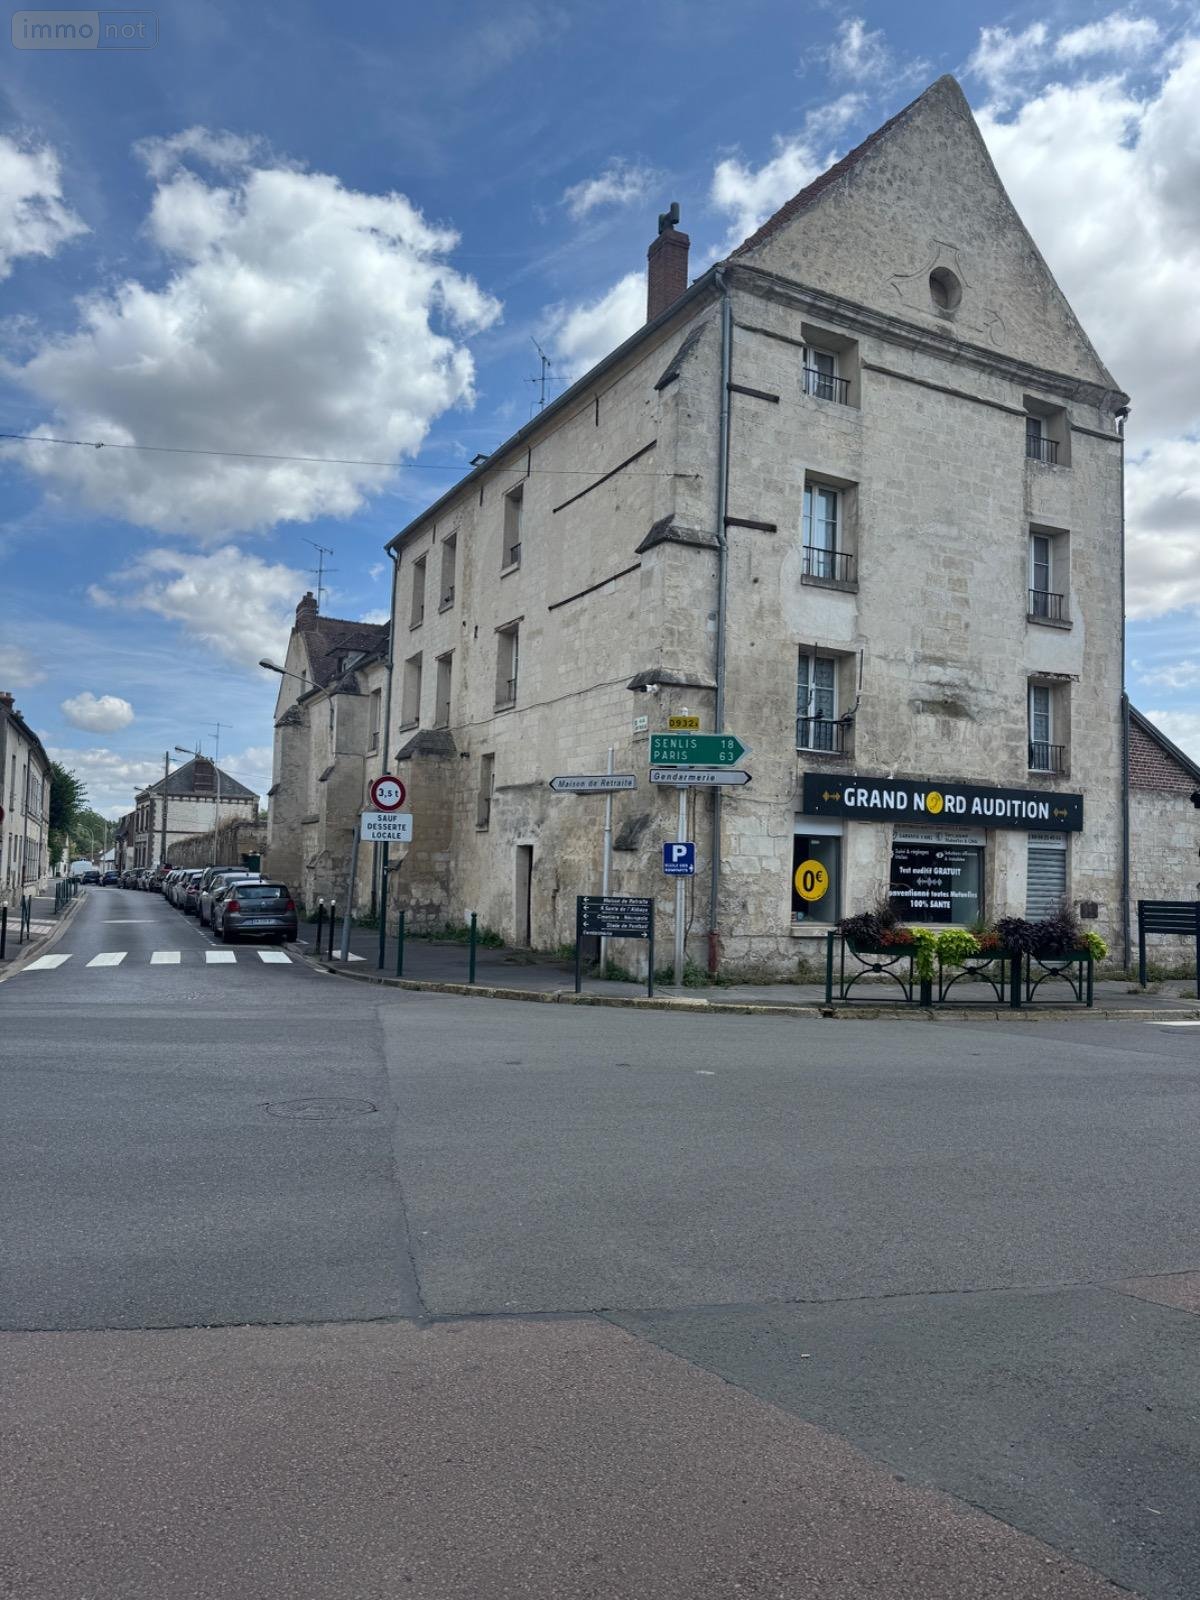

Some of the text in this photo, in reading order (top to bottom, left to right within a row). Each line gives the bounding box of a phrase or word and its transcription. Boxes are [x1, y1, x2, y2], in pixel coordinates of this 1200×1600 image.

[654, 738, 735, 749] SENLIS 18
[653, 750, 735, 761] PARIS 63
[653, 772, 716, 781] Gendarmerie
[557, 780, 585, 788] Maison
[600, 778, 632, 787] Retraite
[844, 787, 1049, 820] GRAND NORD AUDITION
[377, 814, 397, 822] SAUF
[367, 822, 407, 831] DESSERTE
[371, 831, 401, 840] LOCALE
[672, 844, 688, 863] P
[933, 867, 962, 876] GRATUIT
[888, 889, 930, 898] onventionné
[910, 900, 929, 908] 100%
